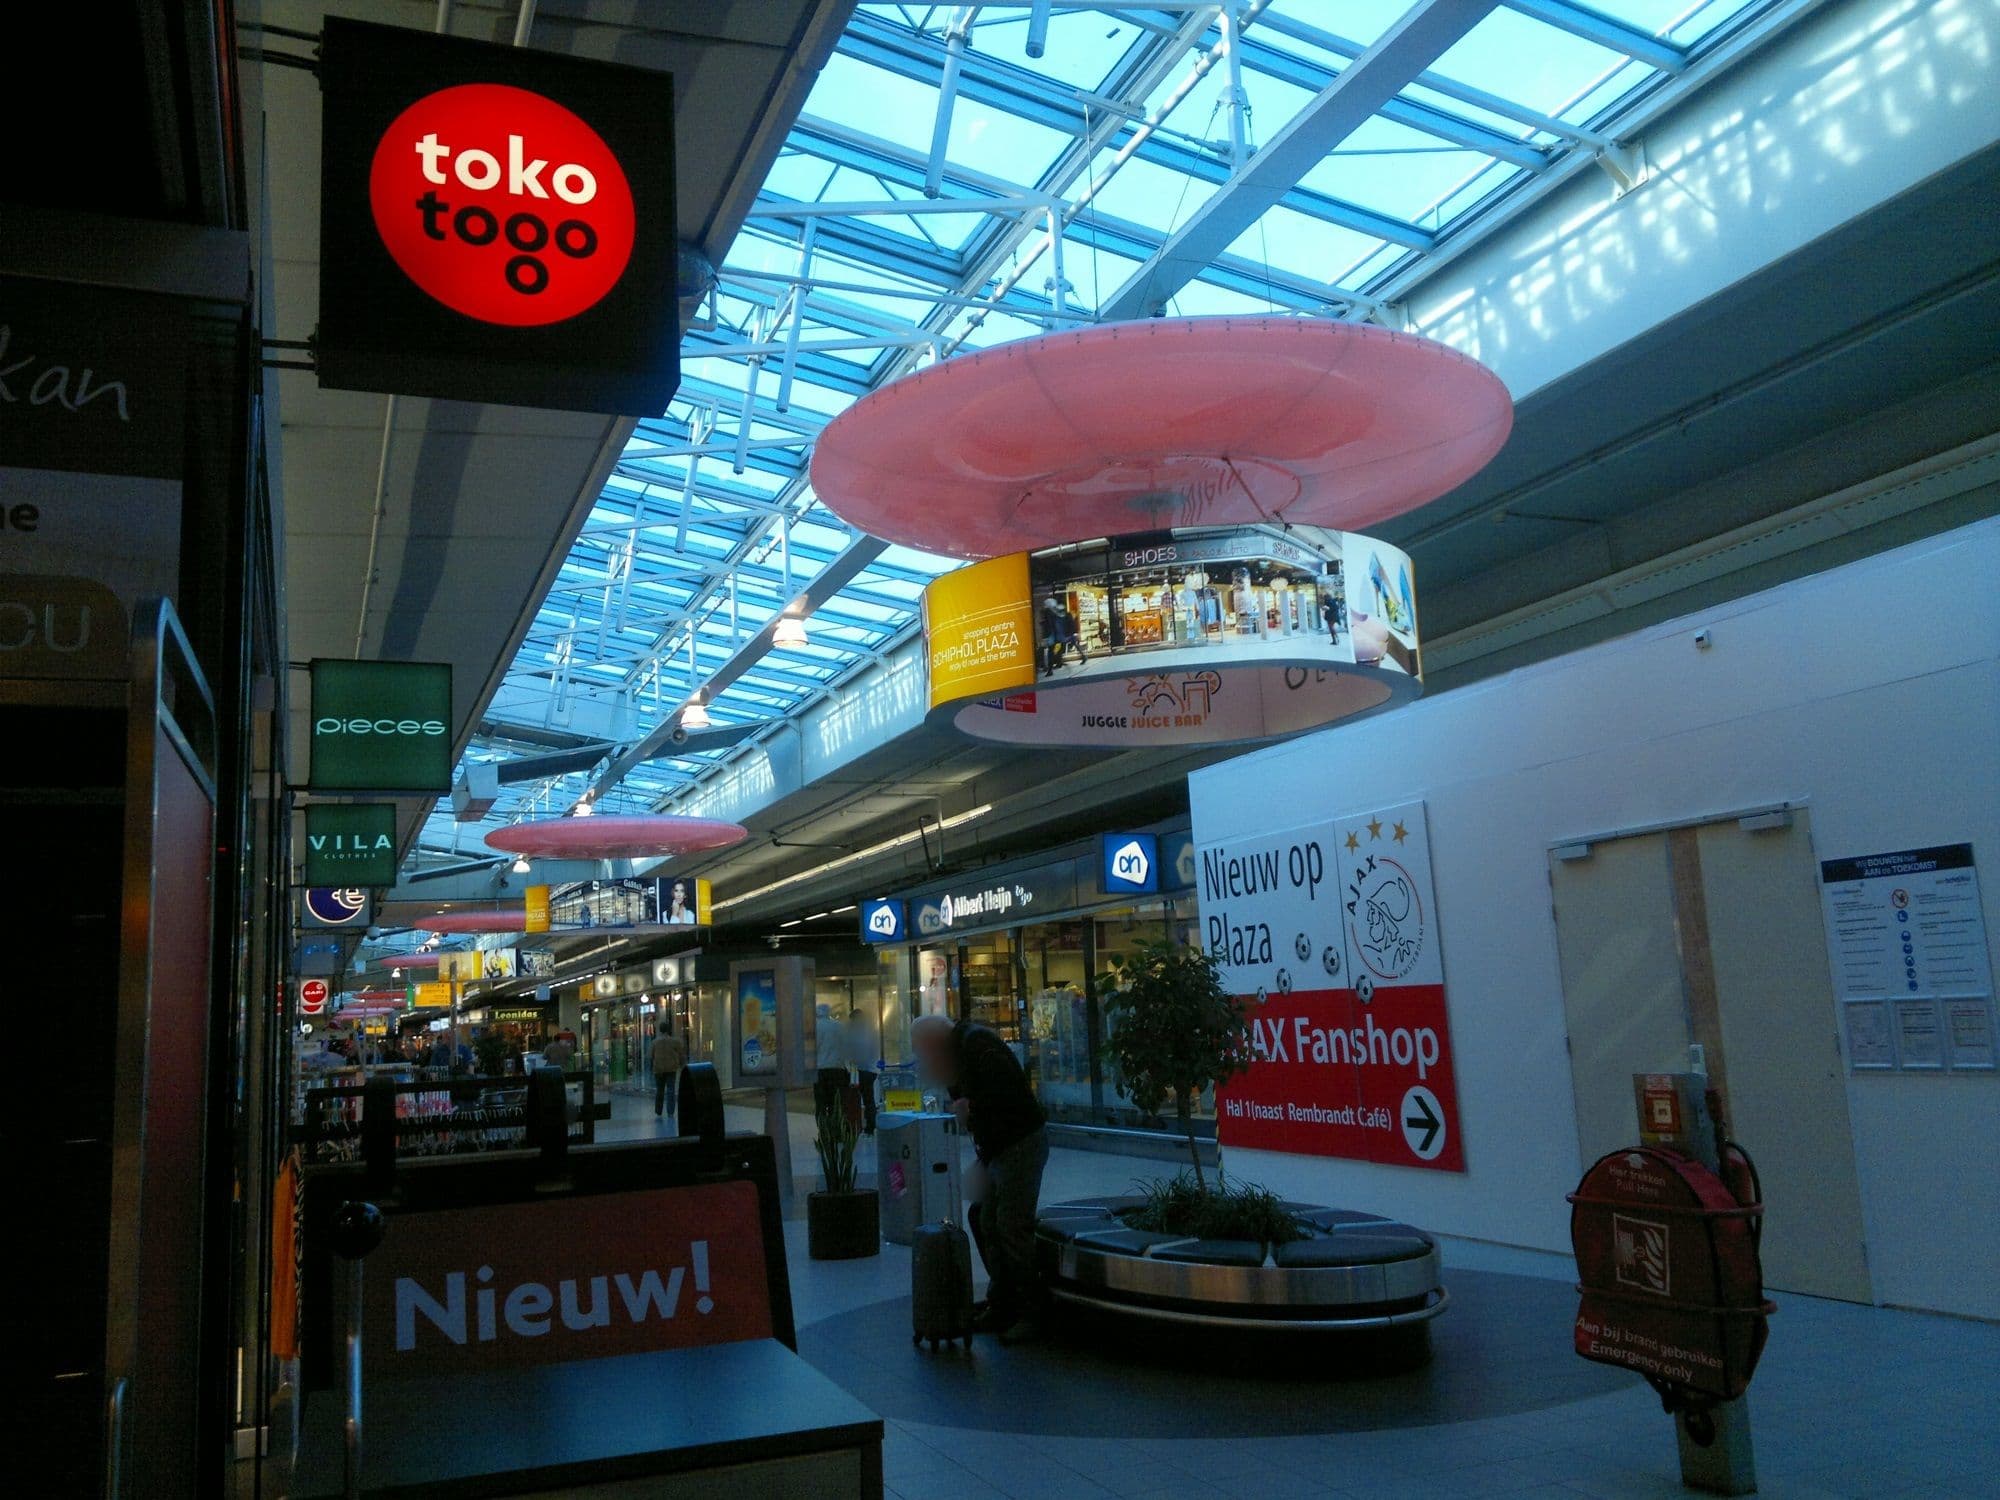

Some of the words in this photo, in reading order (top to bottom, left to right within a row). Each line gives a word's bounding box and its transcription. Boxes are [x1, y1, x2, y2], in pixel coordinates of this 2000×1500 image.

[415, 133, 598, 205] toko
[1124, 546, 1178, 567] SHOES
[963, 626, 991, 641] shopping
[990, 620, 1015, 633] centre
[933, 641, 976, 669] SCHIPHOL
[976, 631, 1020, 654] PLAZA
[986, 653, 999, 663] the
[999, 649, 1017, 660] time
[316, 718, 446, 736] pieces
[1082, 715, 1127, 729] JUGGLE
[1131, 715, 1171, 729] JUICE
[1175, 715, 1203, 728] BAR
[309, 833, 392, 850] VILA
[1203, 847, 1280, 902] Nieuw
[1288, 840, 1324, 901] op
[1346, 853, 1378, 917] AJAX
[953, 891, 984, 918] Albert
[983, 885, 1013, 915] Heijn
[1208, 911, 1274, 967] Plaza
[494, 1009, 538, 1021] Leonidas
[1293, 1013, 1440, 1080] Fanshop
[1226, 1098, 1243, 1118] Hal
[1288, 1102, 1356, 1126] Rembrandt
[394, 1239, 715, 1352] Nieuw!
[1603, 1323, 1621, 1344] bij
[1625, 1330, 1658, 1351] brand
[1590, 1340, 1661, 1374] Emergency
[1663, 1363, 1694, 1384] only
